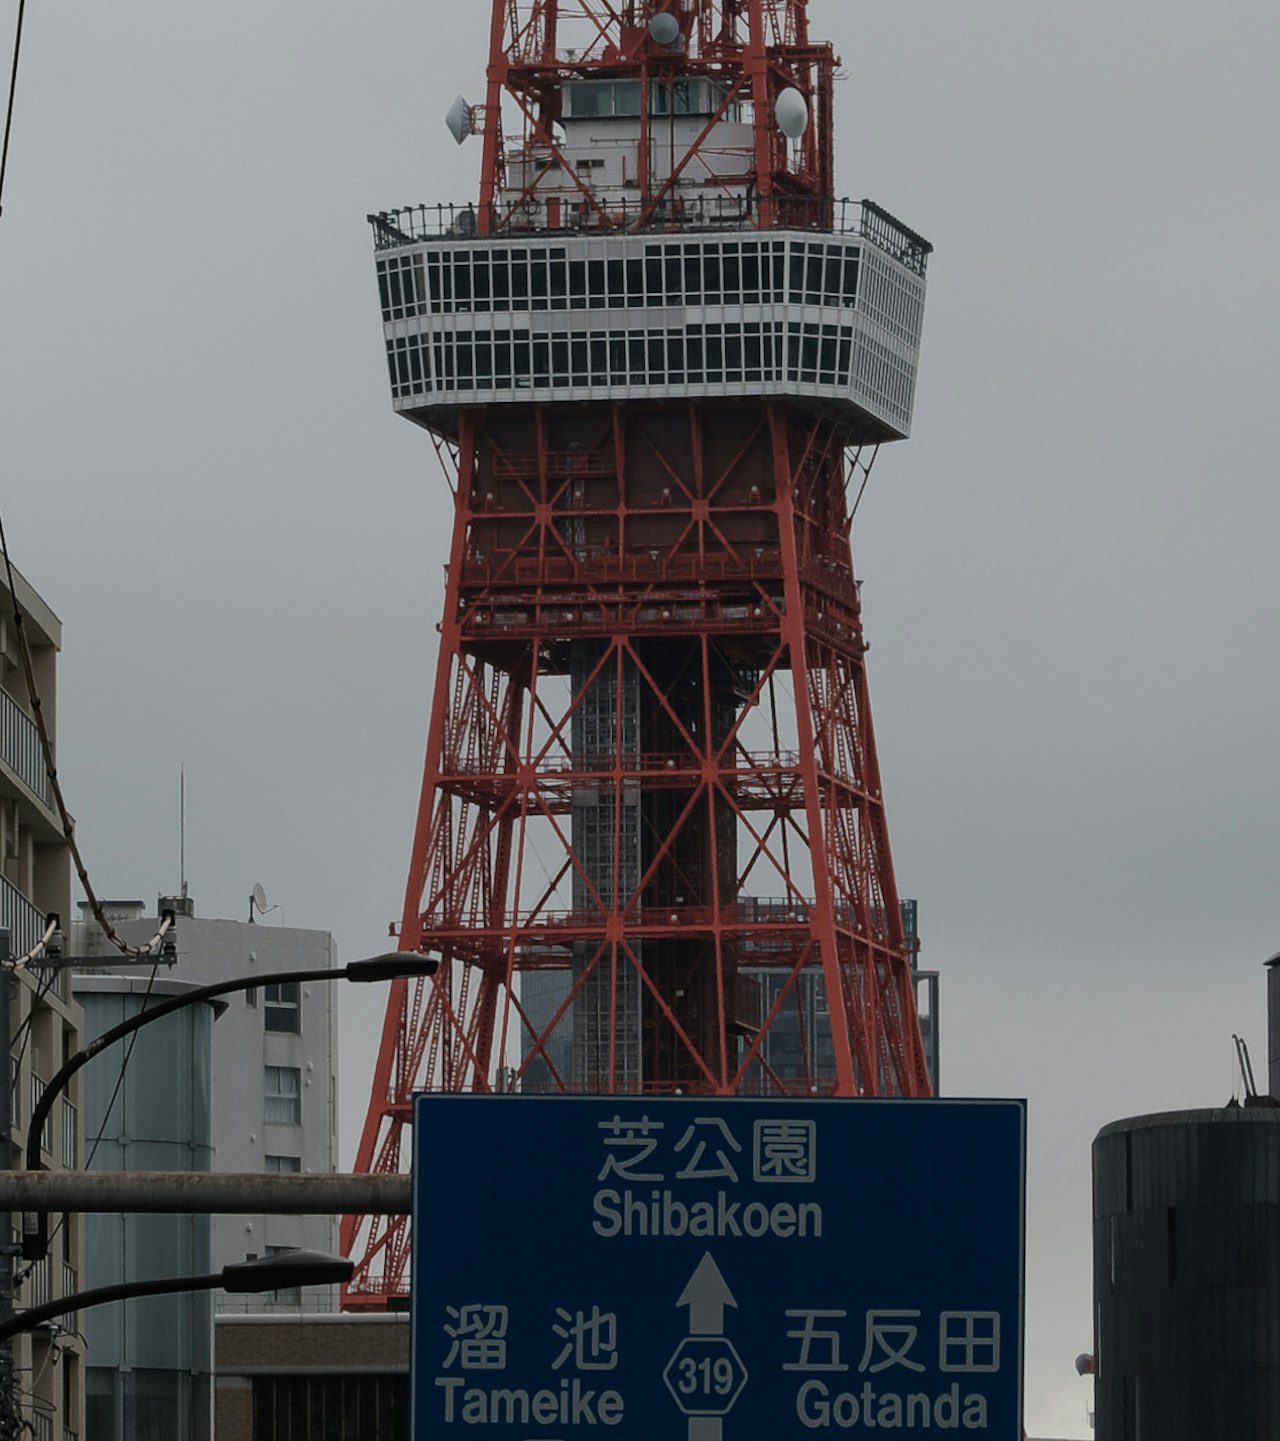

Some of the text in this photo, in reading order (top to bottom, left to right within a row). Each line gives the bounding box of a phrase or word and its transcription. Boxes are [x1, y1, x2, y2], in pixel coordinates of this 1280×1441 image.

[597, 1115, 818, 1184] 芝公園
[592, 1190, 823, 1238] Shibakoen
[442, 1304, 619, 1371] 溜池
[782, 1308, 1001, 1373] 五反田
[434, 1376, 625, 1425] Tameike
[677, 1356, 734, 1396] 319
[796, 1379, 988, 1429] Gotanda
